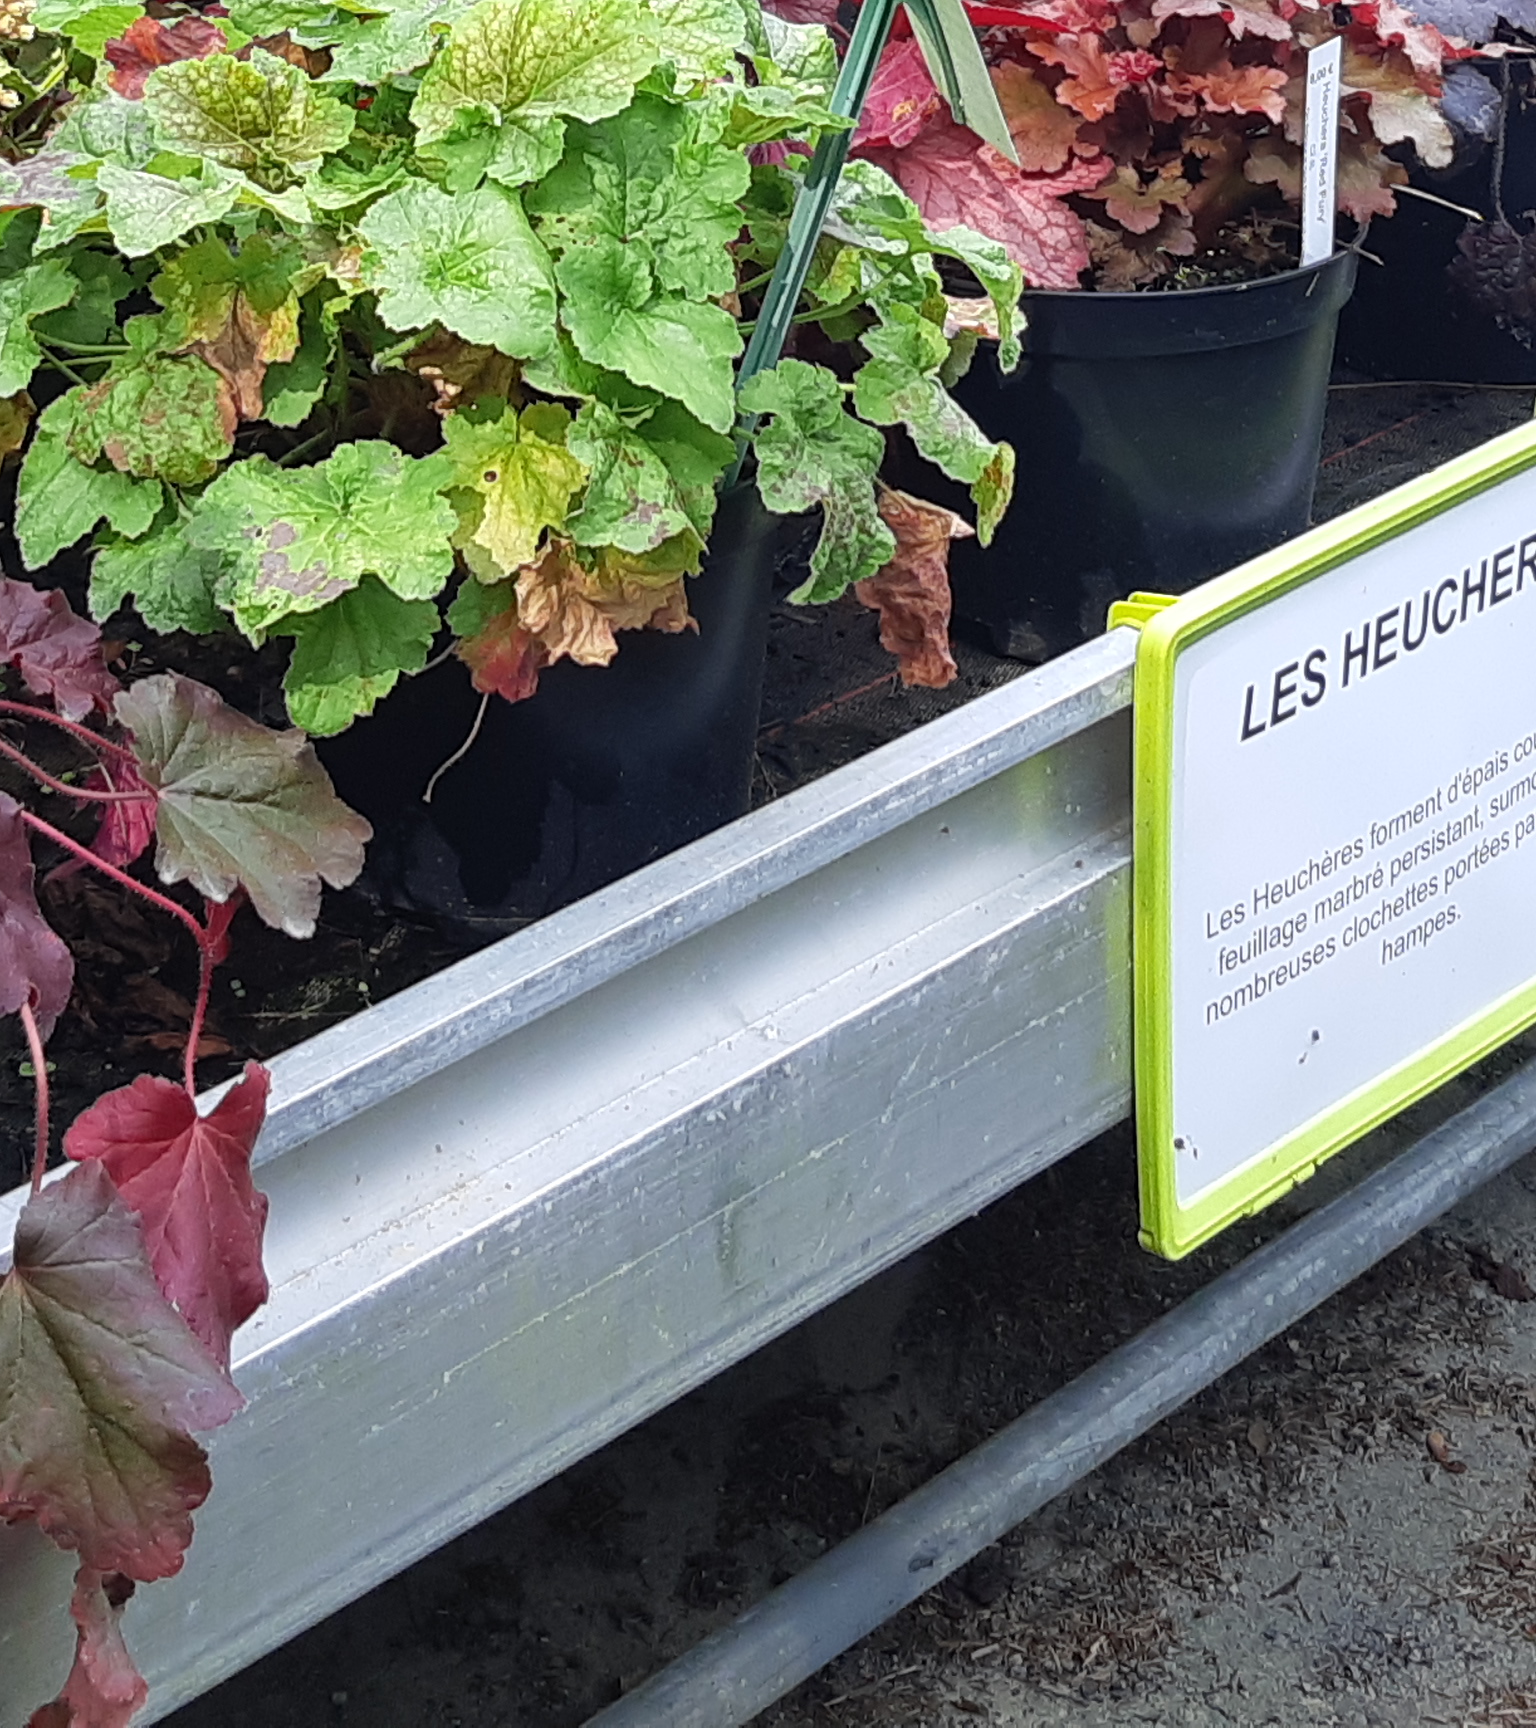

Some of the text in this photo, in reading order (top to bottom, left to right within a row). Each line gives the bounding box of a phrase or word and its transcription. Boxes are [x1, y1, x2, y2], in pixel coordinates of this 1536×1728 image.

[1240, 648, 1327, 742] LES
[1206, 937, 1336, 1025] nombreuses
[1342, 876, 1438, 947] clochettes
[1444, 831, 1510, 894] portées
[1207, 903, 1245, 939] Les
[1253, 838, 1364, 914] Heuchères
[1370, 788, 1443, 849] forment
[1447, 752, 1509, 804] d'épais
[1219, 912, 1308, 975] feuillage
[1315, 867, 1384, 924] marbré
[1390, 806, 1484, 886] persistant,
[1382, 905, 1462, 965] hampes.
